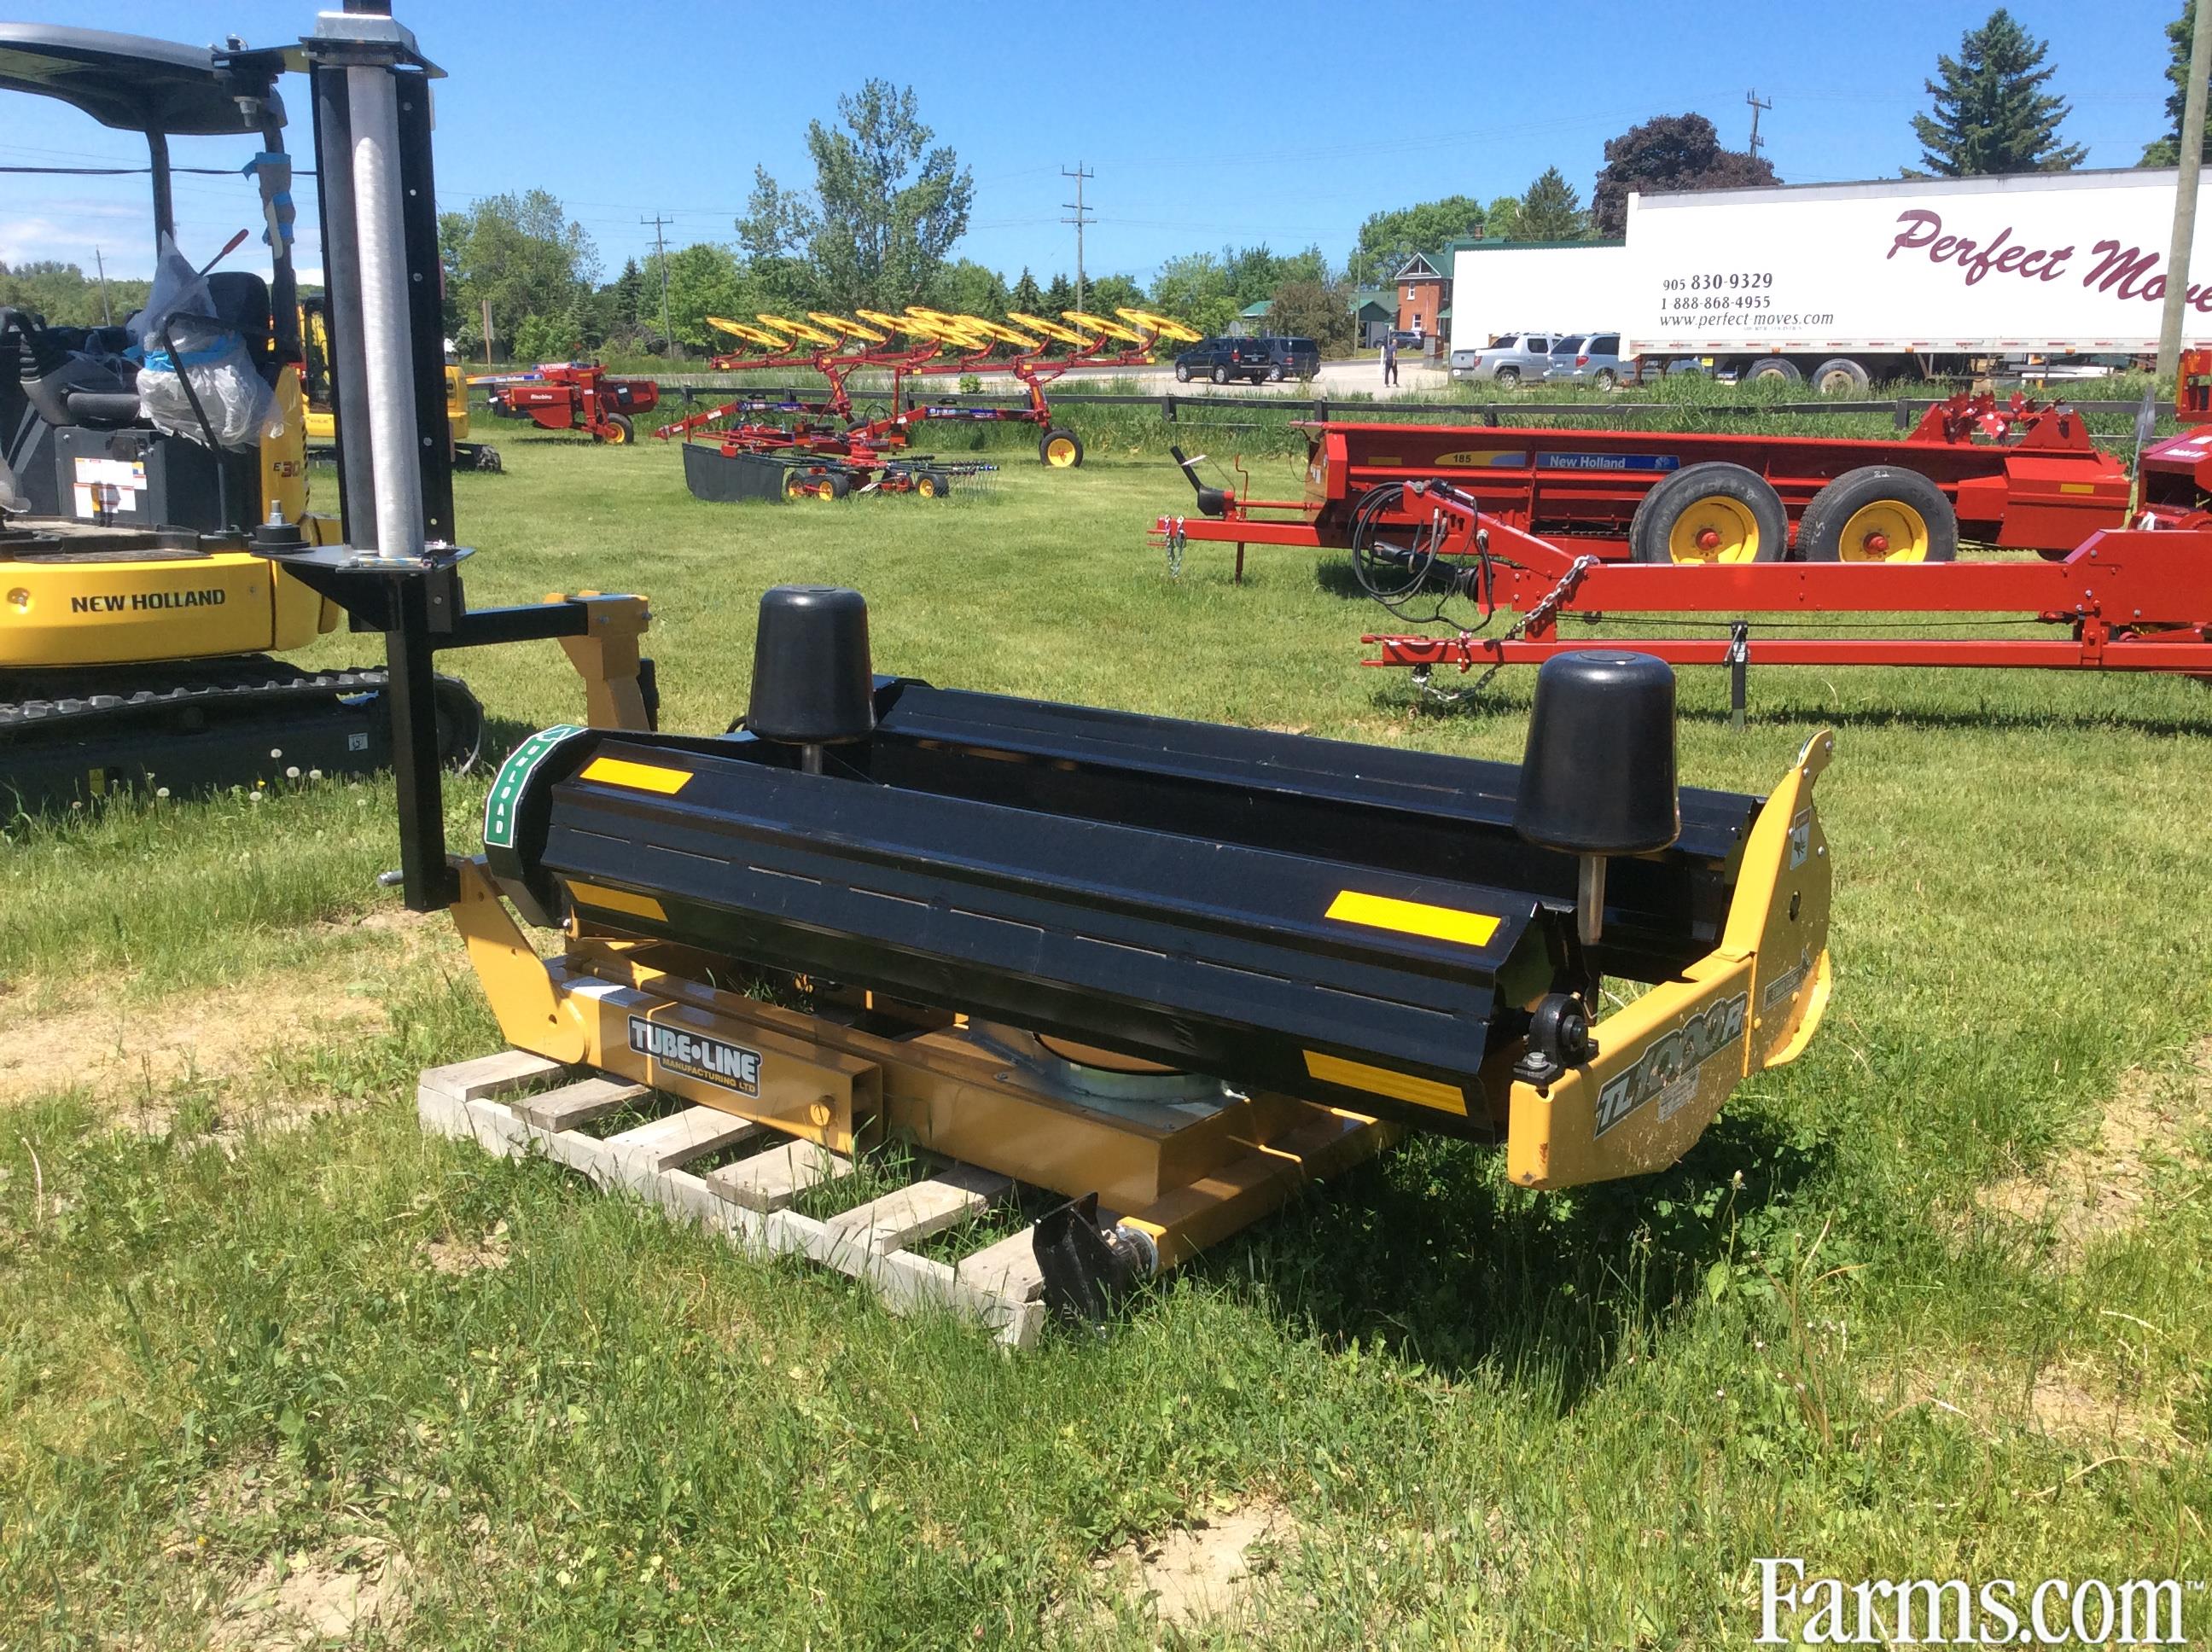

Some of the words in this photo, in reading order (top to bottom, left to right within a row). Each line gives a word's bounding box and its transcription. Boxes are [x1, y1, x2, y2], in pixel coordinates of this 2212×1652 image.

[1886, 209, 2075, 286] Perfect
[1663, 279, 1686, 291] 905
[1691, 272, 1773, 290] 830-9329
[1660, 312, 1834, 329] www.perfect-moves.com
[1452, 454, 1472, 462] 185
[1550, 455, 1577, 468] New
[1580, 457, 1627, 468] Holland
[72, 595, 125, 613] NEW
[131, 589, 226, 610] HOLLAND
[495, 745, 540, 834] UNLOAD
[662, 1058, 736, 1086] MANUFACTURING
[739, 1082, 755, 1093] LTD
